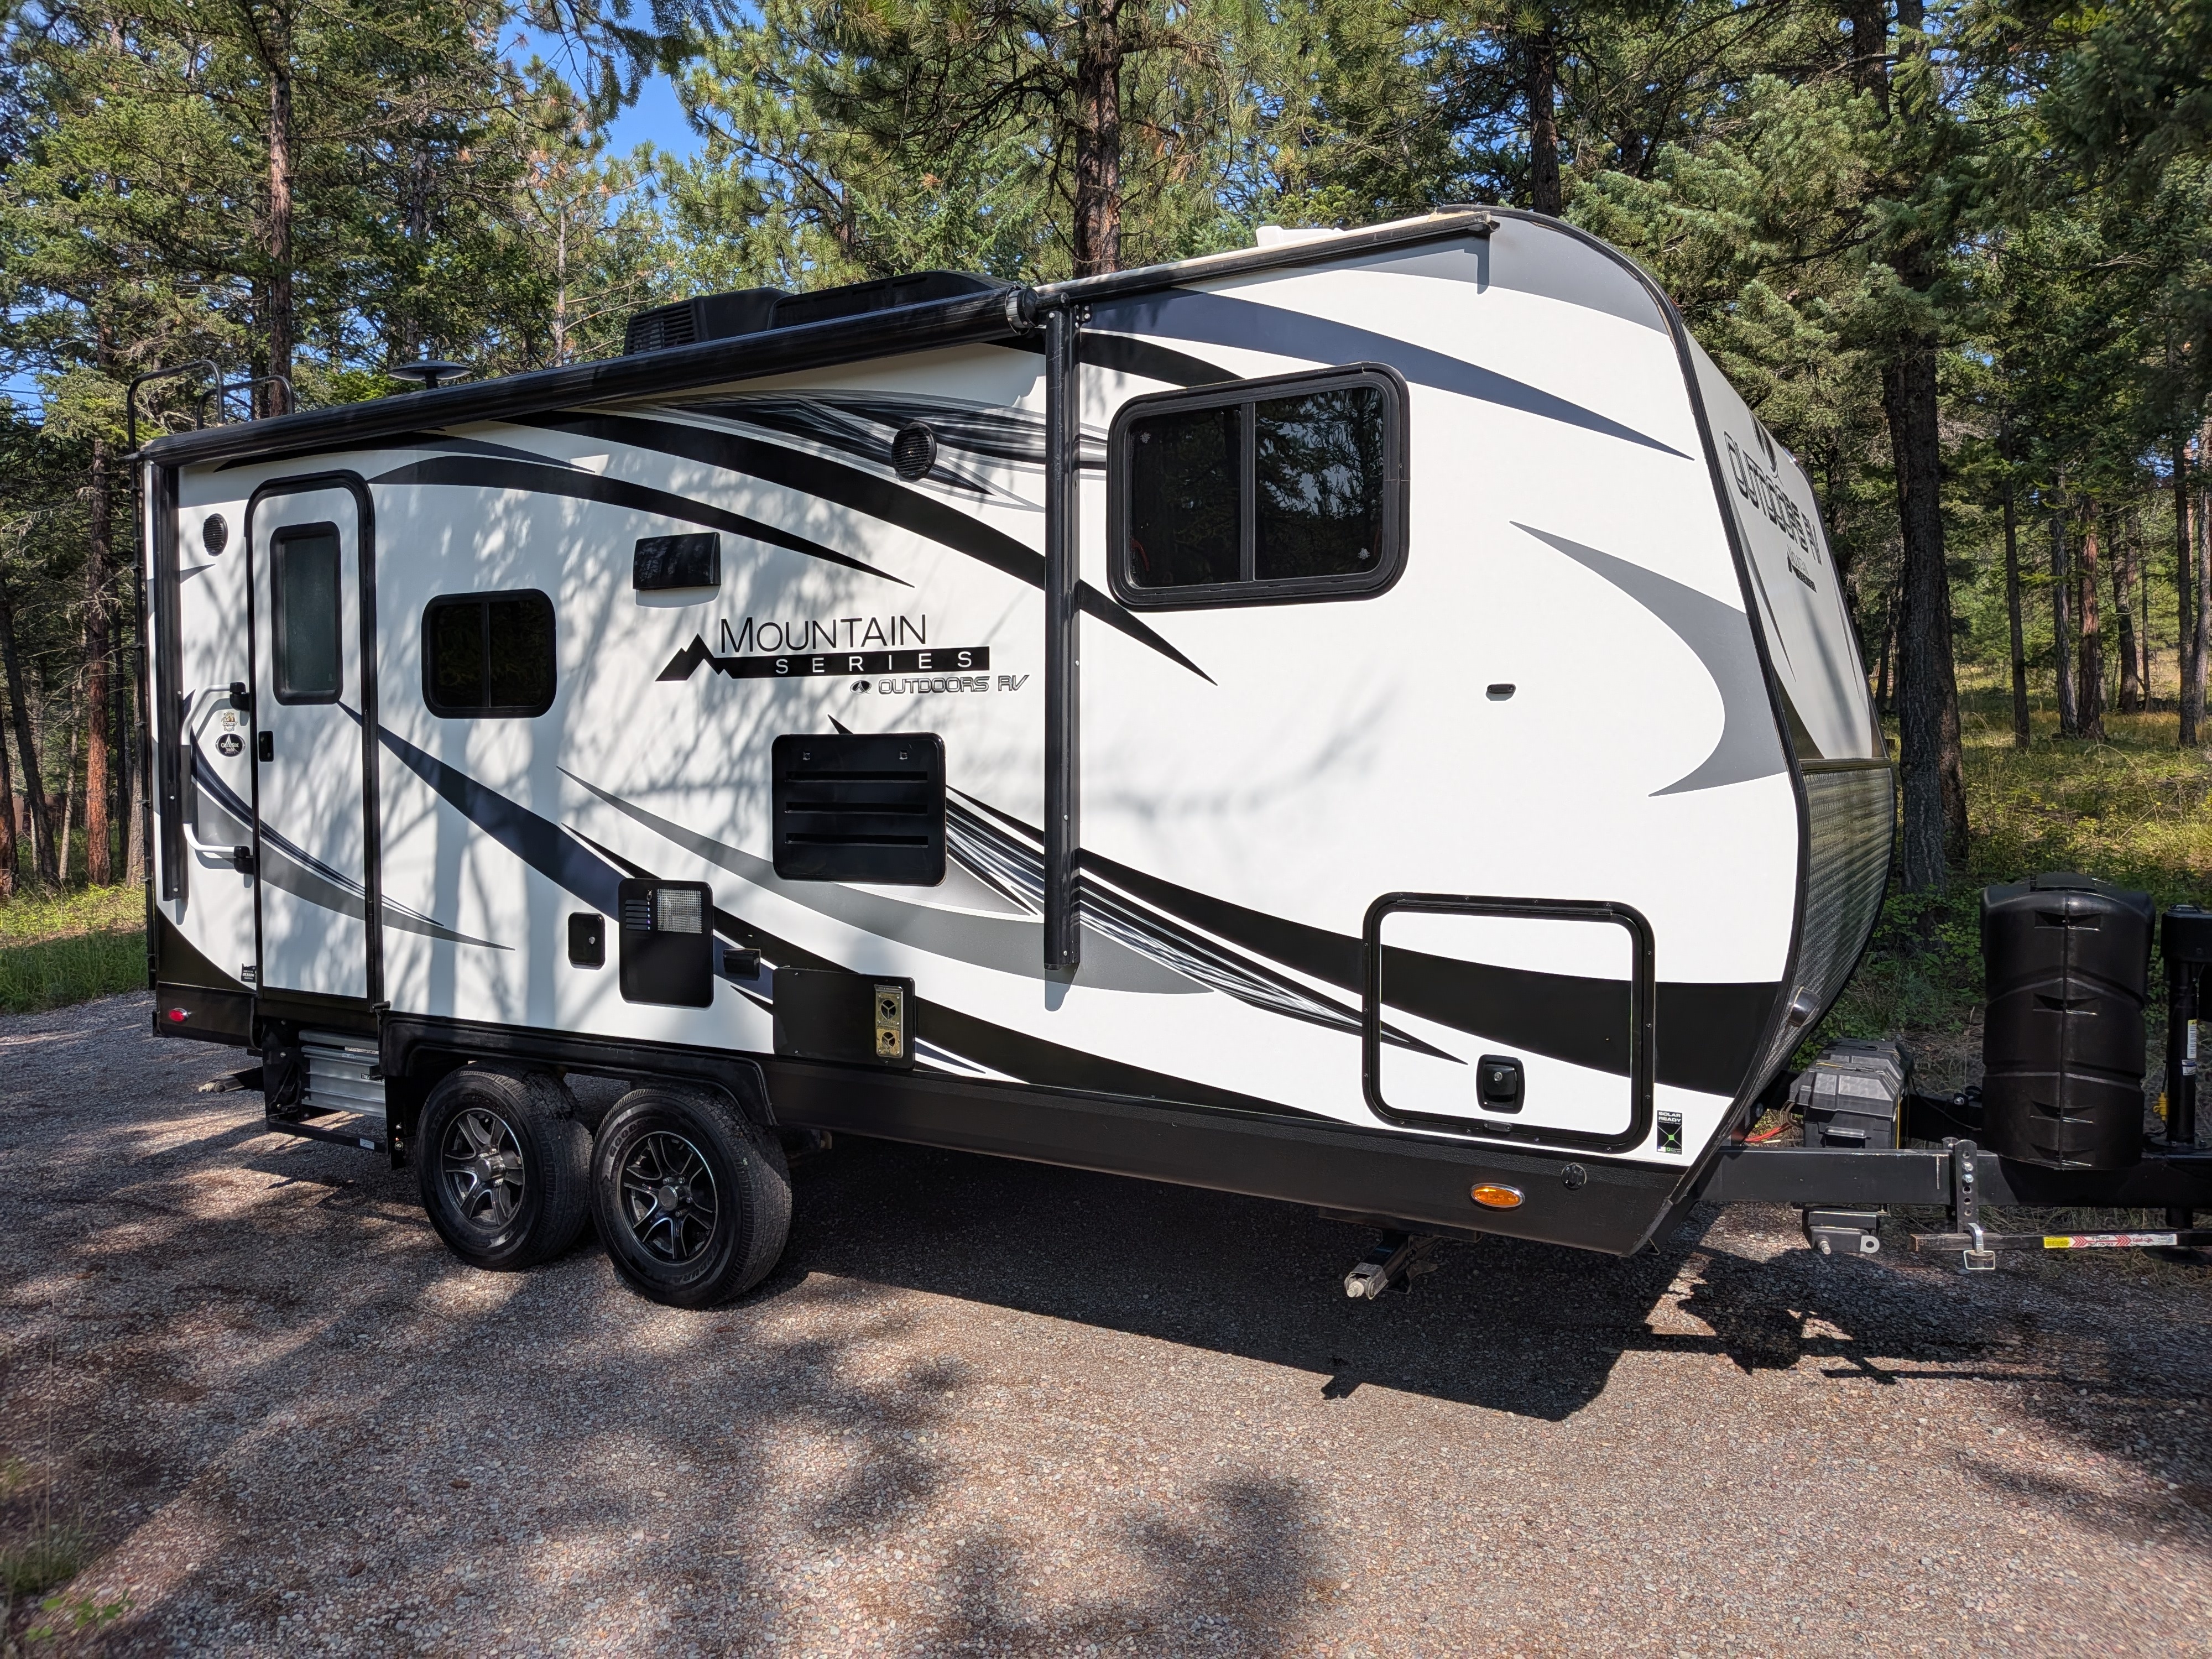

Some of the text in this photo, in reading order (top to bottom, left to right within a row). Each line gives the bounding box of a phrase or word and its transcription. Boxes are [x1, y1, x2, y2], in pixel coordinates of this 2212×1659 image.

[1724, 430, 1809, 554] OUTDOORS
[720, 614, 926, 654] MOUNTAIN
[775, 651, 972, 675] SERIES
[878, 674, 1030, 695] OUTDOORS RV
